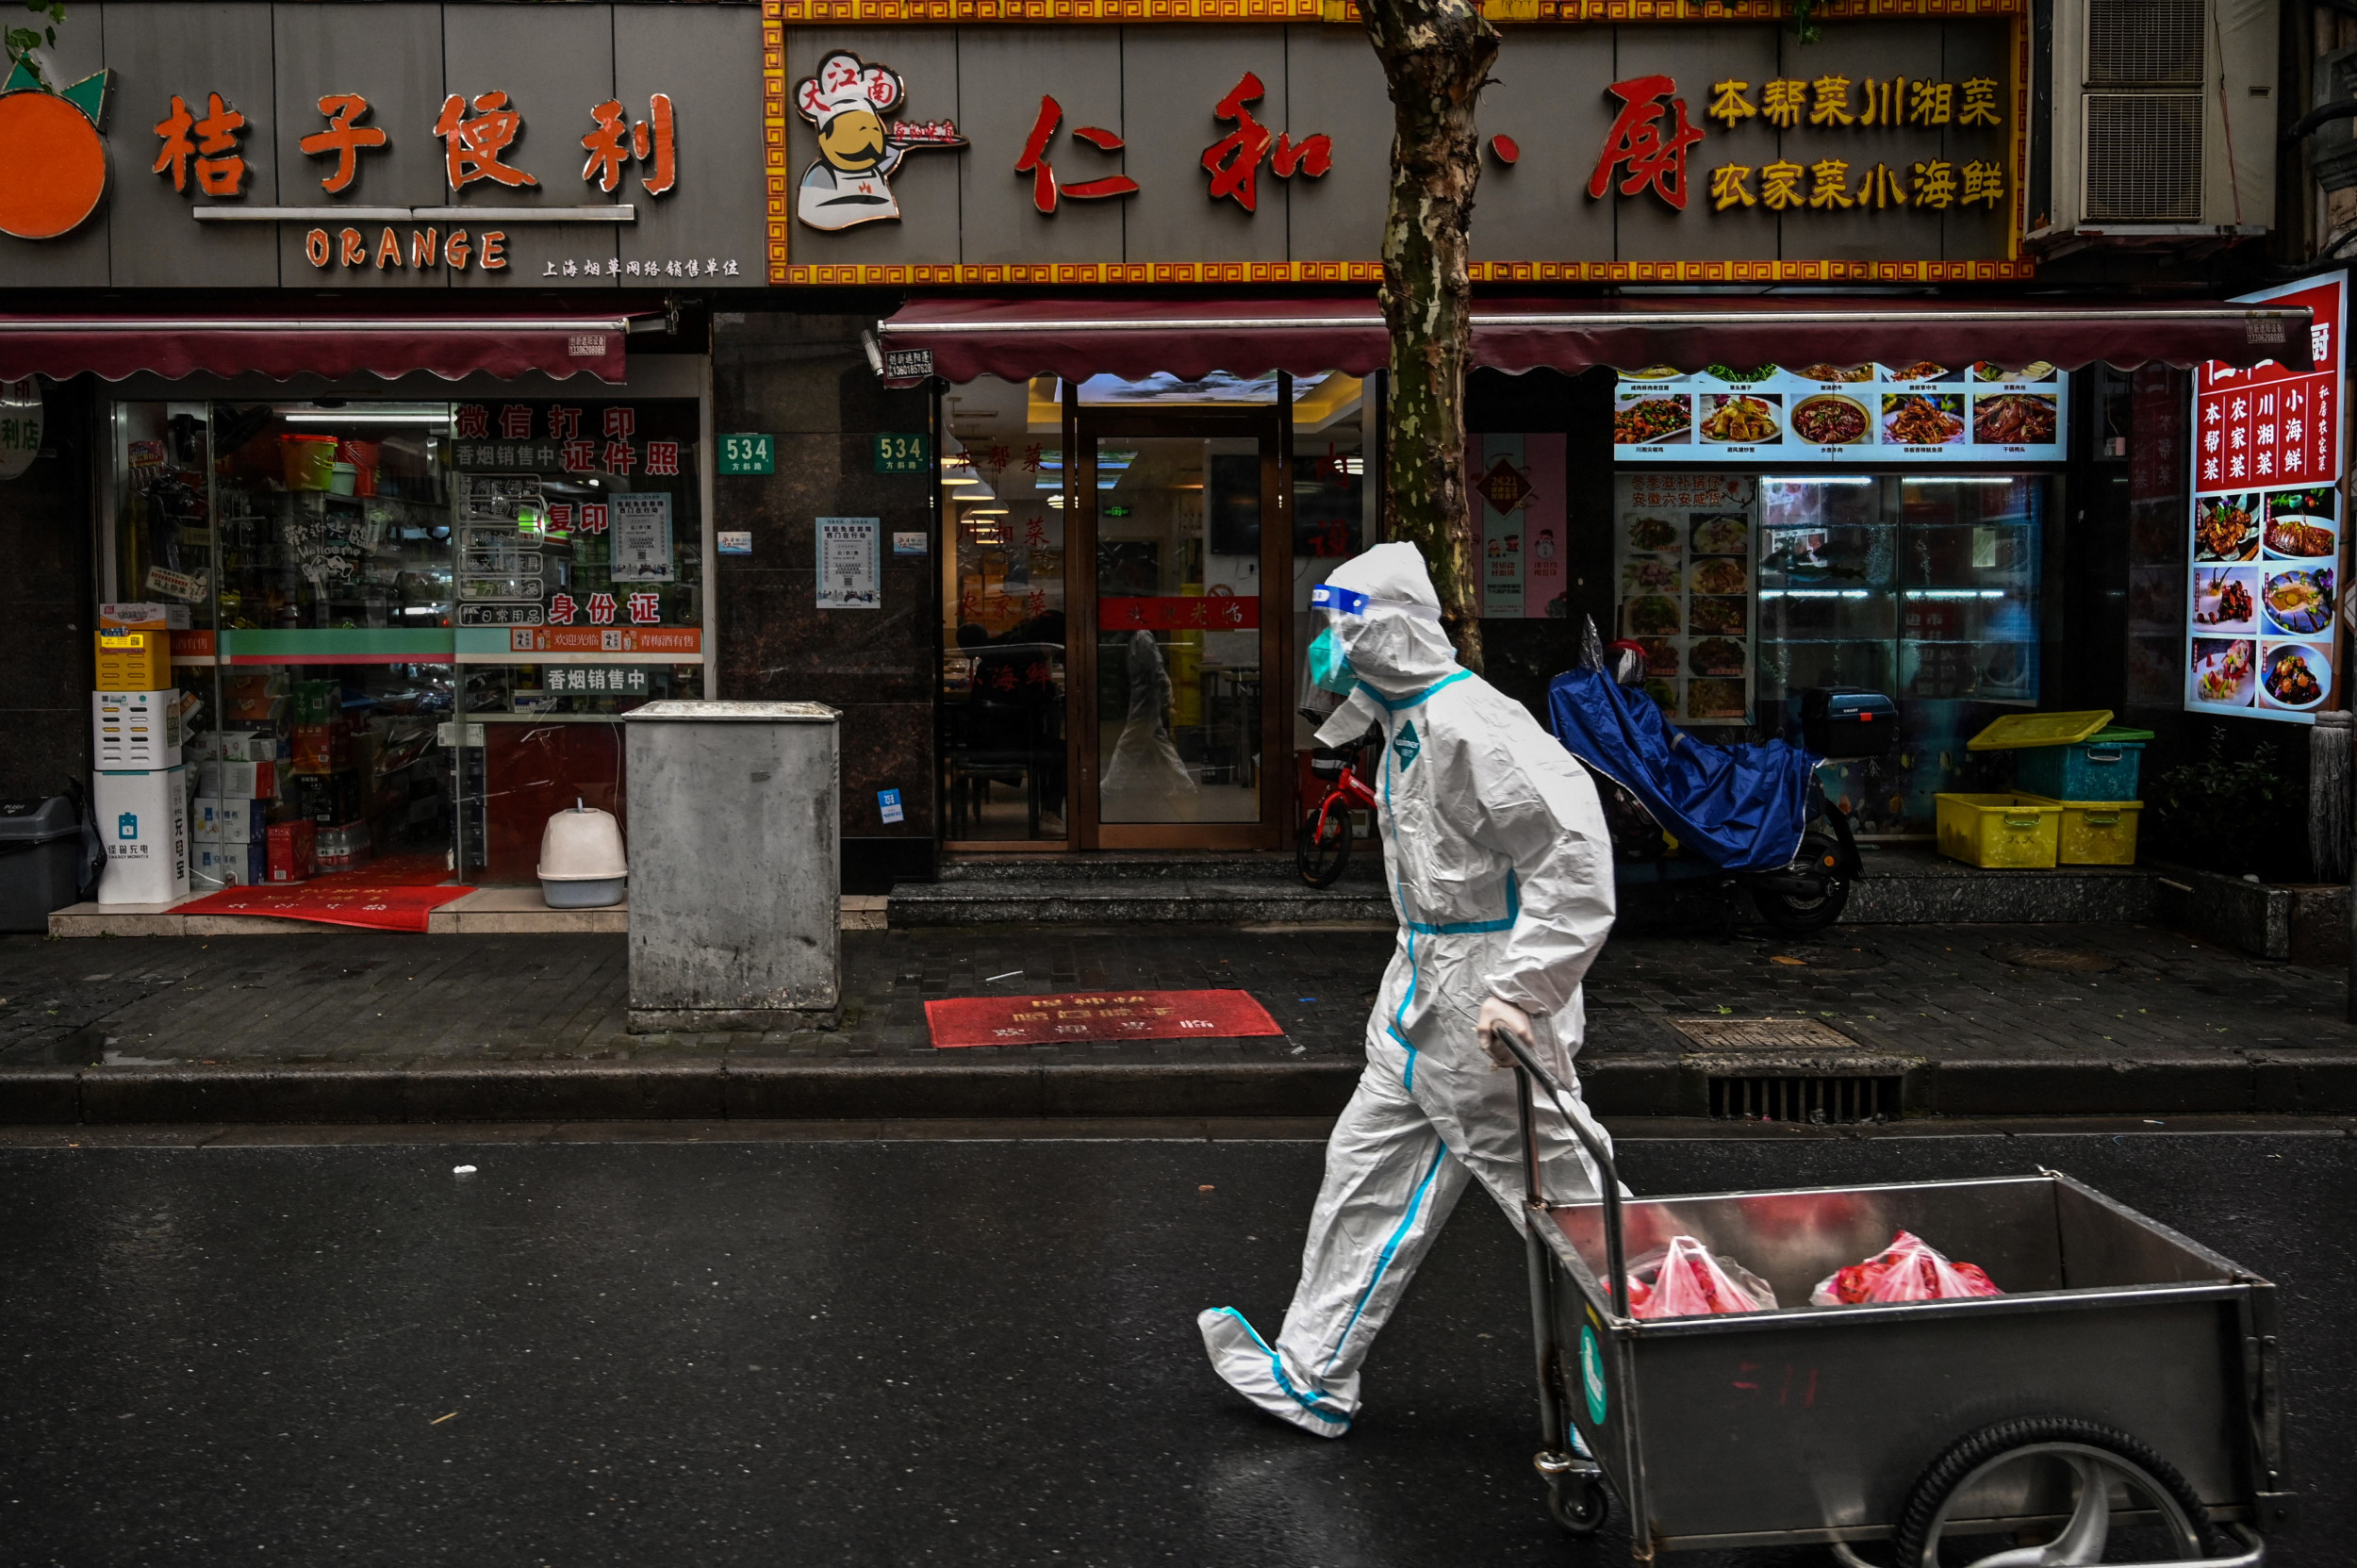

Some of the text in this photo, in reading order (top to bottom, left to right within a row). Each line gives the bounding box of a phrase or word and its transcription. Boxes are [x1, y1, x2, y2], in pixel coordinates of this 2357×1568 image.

[802, 61, 894, 111] 大江南
[1708, 74, 2002, 128] 本帮菜川湘菜
[151, 91, 675, 195] 桔子便利
[1015, 72, 1705, 212] 仁和厨
[1710, 157, 2004, 210] 农家菜小海鲜
[305, 226, 508, 271] ORANGE
[542, 257, 740, 278] 上海烟草网络销售单位
[454, 404, 636, 441] 微信打印
[2229, 397, 2248, 478] 农家菜
[2256, 393, 2274, 476] 川湘菜
[2284, 389, 2303, 472] 小海鲜
[2317, 385, 2330, 471] 私房农家菜
[456, 446, 554, 468] 香烟销售中
[561, 440, 679, 476] 证件照
[727, 438, 767, 460] 534
[881, 437, 921, 459] 534
[952, 442, 1048, 474] 本帮菜
[2203, 403, 2222, 481] 本帮菜
[732, 462, 763, 471] 方斜路
[1632, 475, 1722, 490] 冬季滋补锅仔
[546, 503, 609, 535] 复印
[955, 518, 1050, 547] 川湘菜
[481, 609, 541, 624] 日常用品
[547, 593, 661, 625] 身份证
[554, 634, 600, 647] 欢迎光临
[640, 634, 695, 648] 青梅酒有售
[548, 668, 645, 690] 香烟销售中
[107, 844, 149, 854] 怪兽充电
